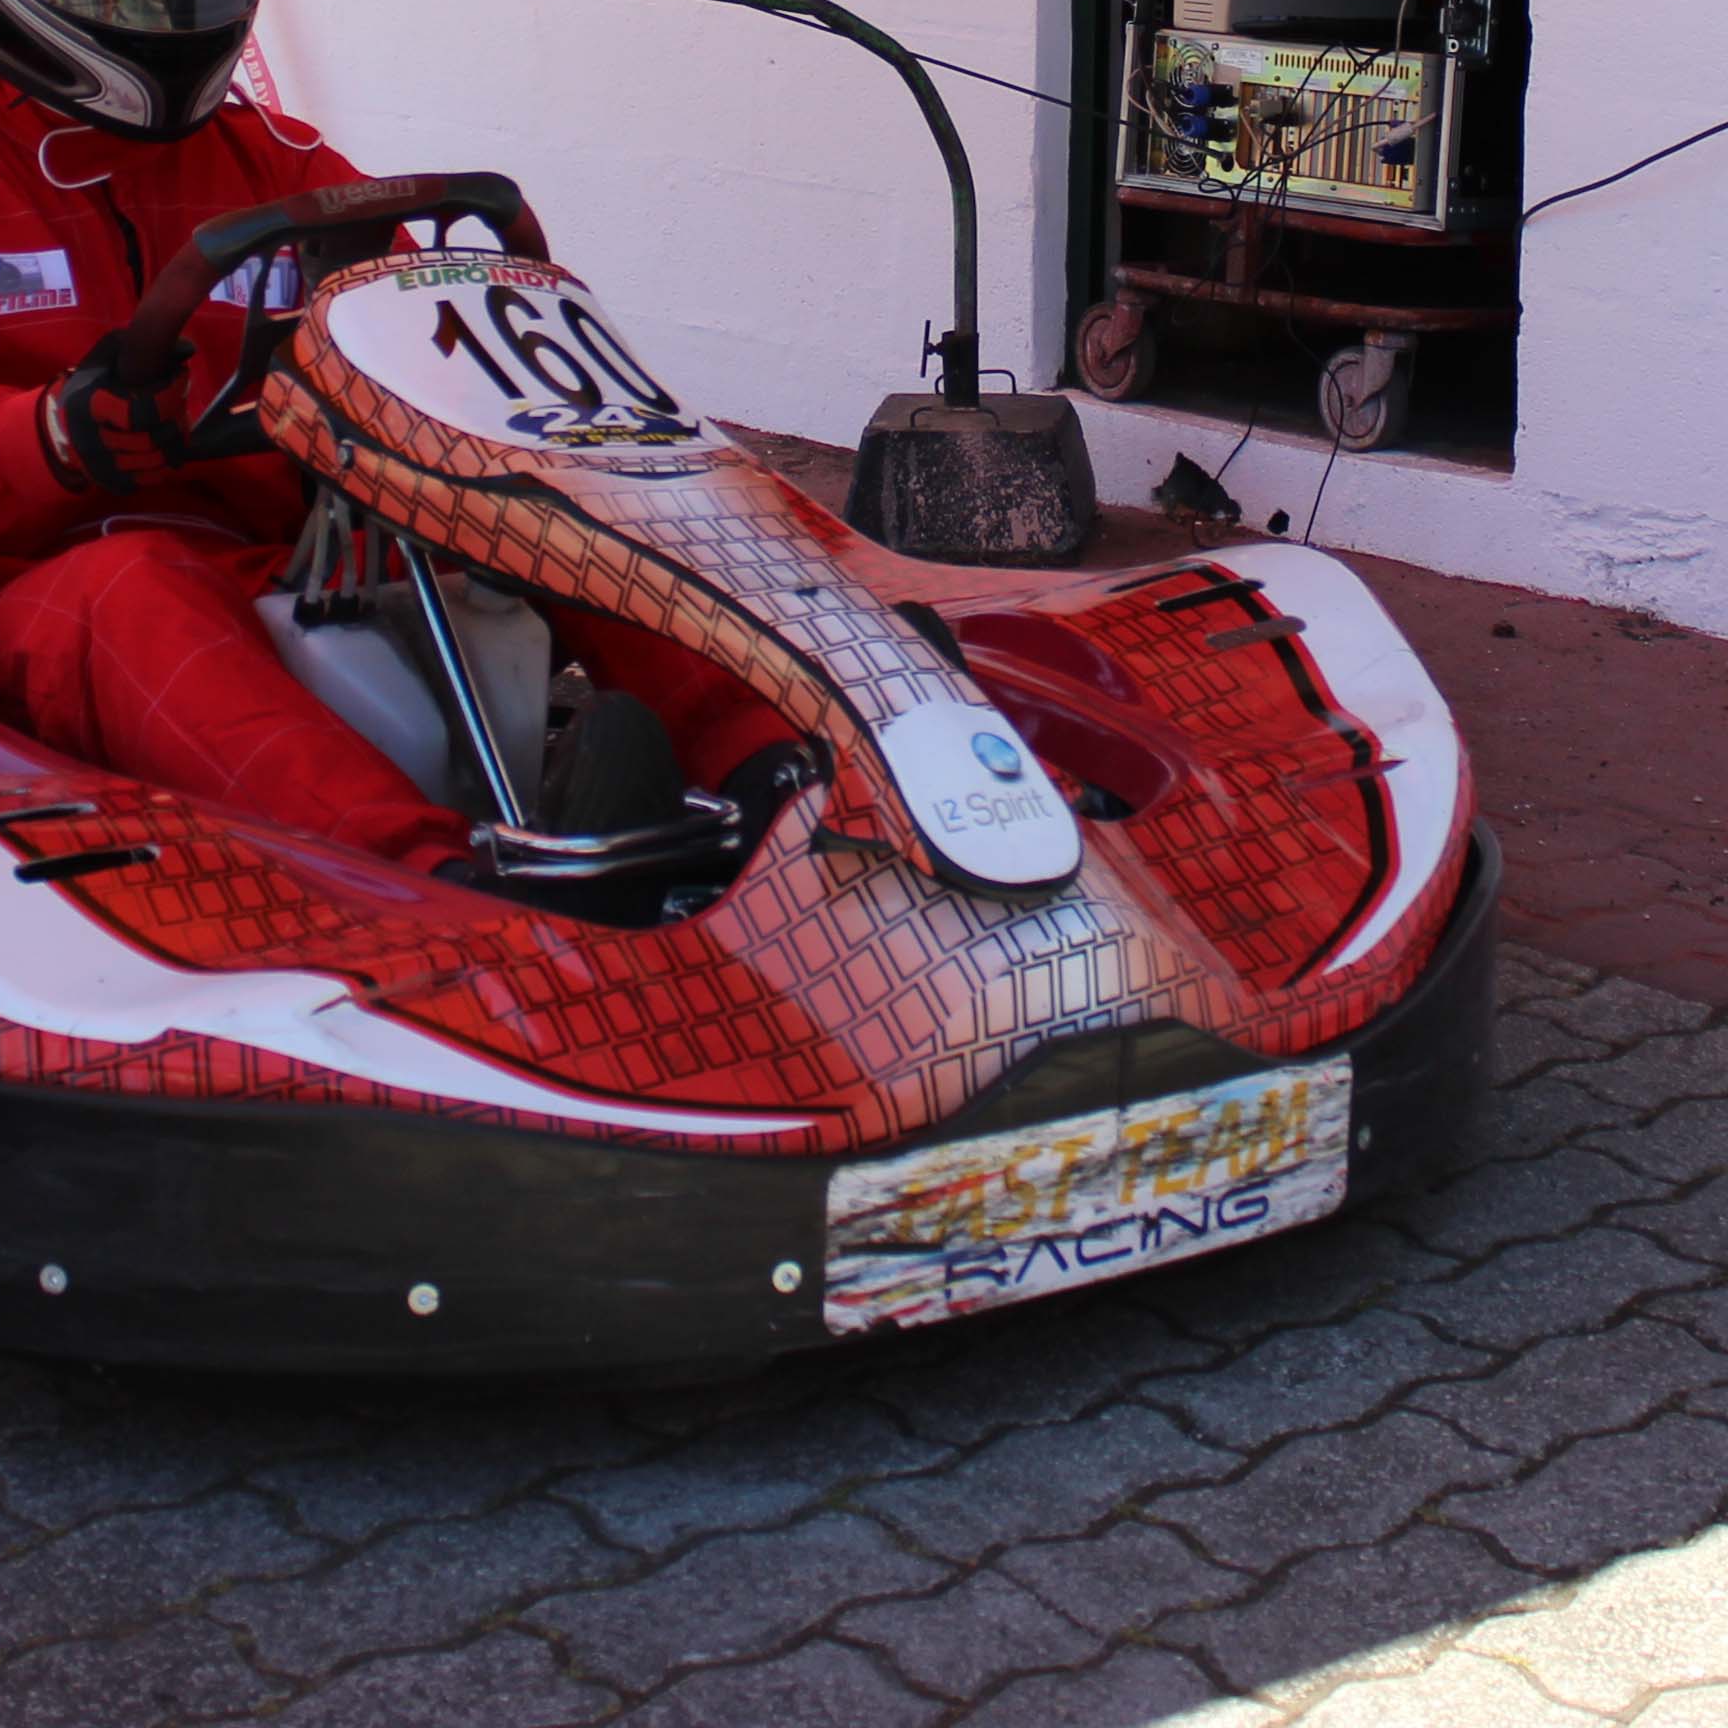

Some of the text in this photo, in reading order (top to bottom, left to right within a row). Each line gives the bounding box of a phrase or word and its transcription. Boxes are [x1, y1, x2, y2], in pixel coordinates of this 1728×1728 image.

[430, 285, 680, 415] 160
[528, 406, 647, 433] 24
[966, 788, 1053, 832] Spirit
